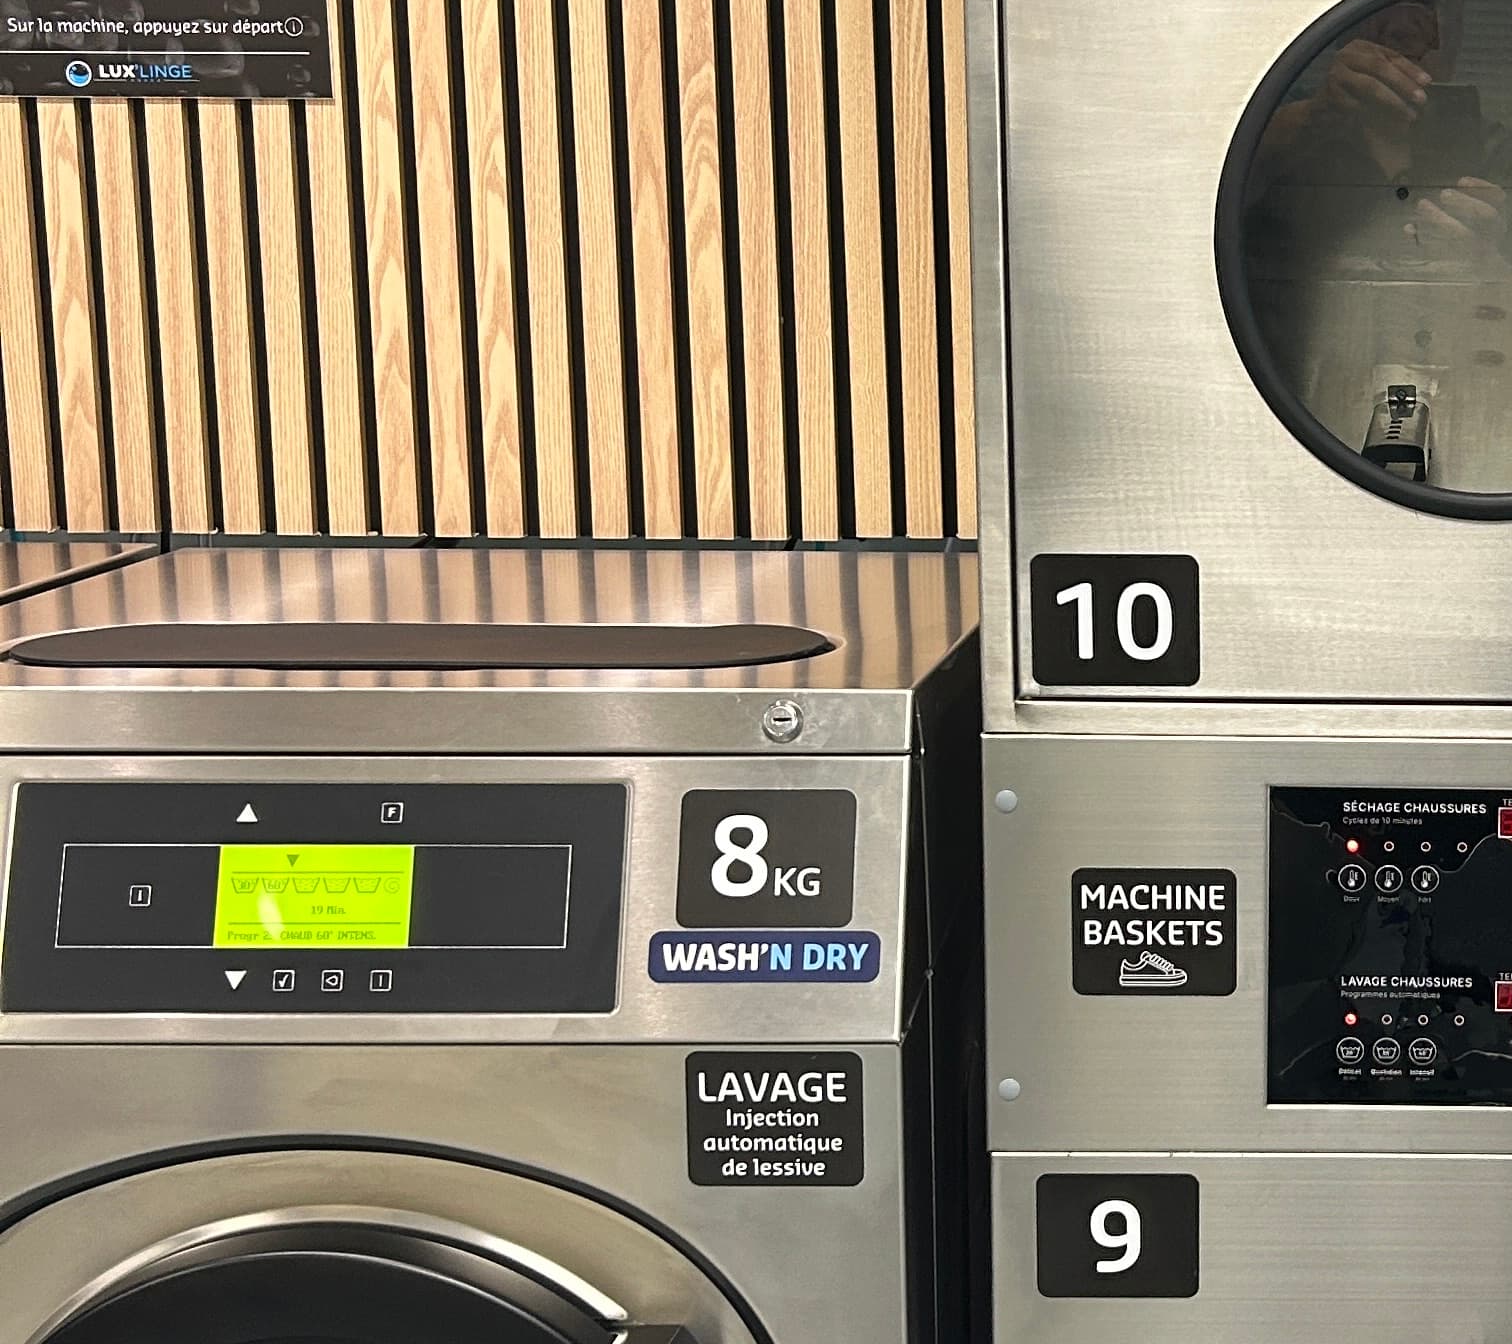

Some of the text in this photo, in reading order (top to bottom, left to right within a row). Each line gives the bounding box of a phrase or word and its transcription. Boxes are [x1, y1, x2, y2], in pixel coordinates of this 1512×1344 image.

[8, 18, 283, 36] Sur la machine, appuyez sur départ
[99, 64, 192, 78] LUX'LINGE
[1057, 583, 1172, 660] 10
[1344, 800, 1486, 813] SÉCHAGE CHAUSSURES
[1081, 885, 1225, 910] MACHINE
[311, 906, 323, 914] 19
[227, 931, 259, 941] Progr
[280, 931, 312, 940] CHAUD
[1085, 920, 1222, 945] BASKETS
[663, 943, 868, 971] WASH'N DRY
[1342, 976, 1472, 988] LAVAGE CHAUSSURES
[1341, 990, 1387, 999] Programmes
[699, 1073, 846, 1102] LAVAGE
[727, 1109, 818, 1130] Injection
[704, 1134, 842, 1154] automatique
[722, 1159, 825, 1176] de lessive
[1091, 1200, 1140, 1272] 9
